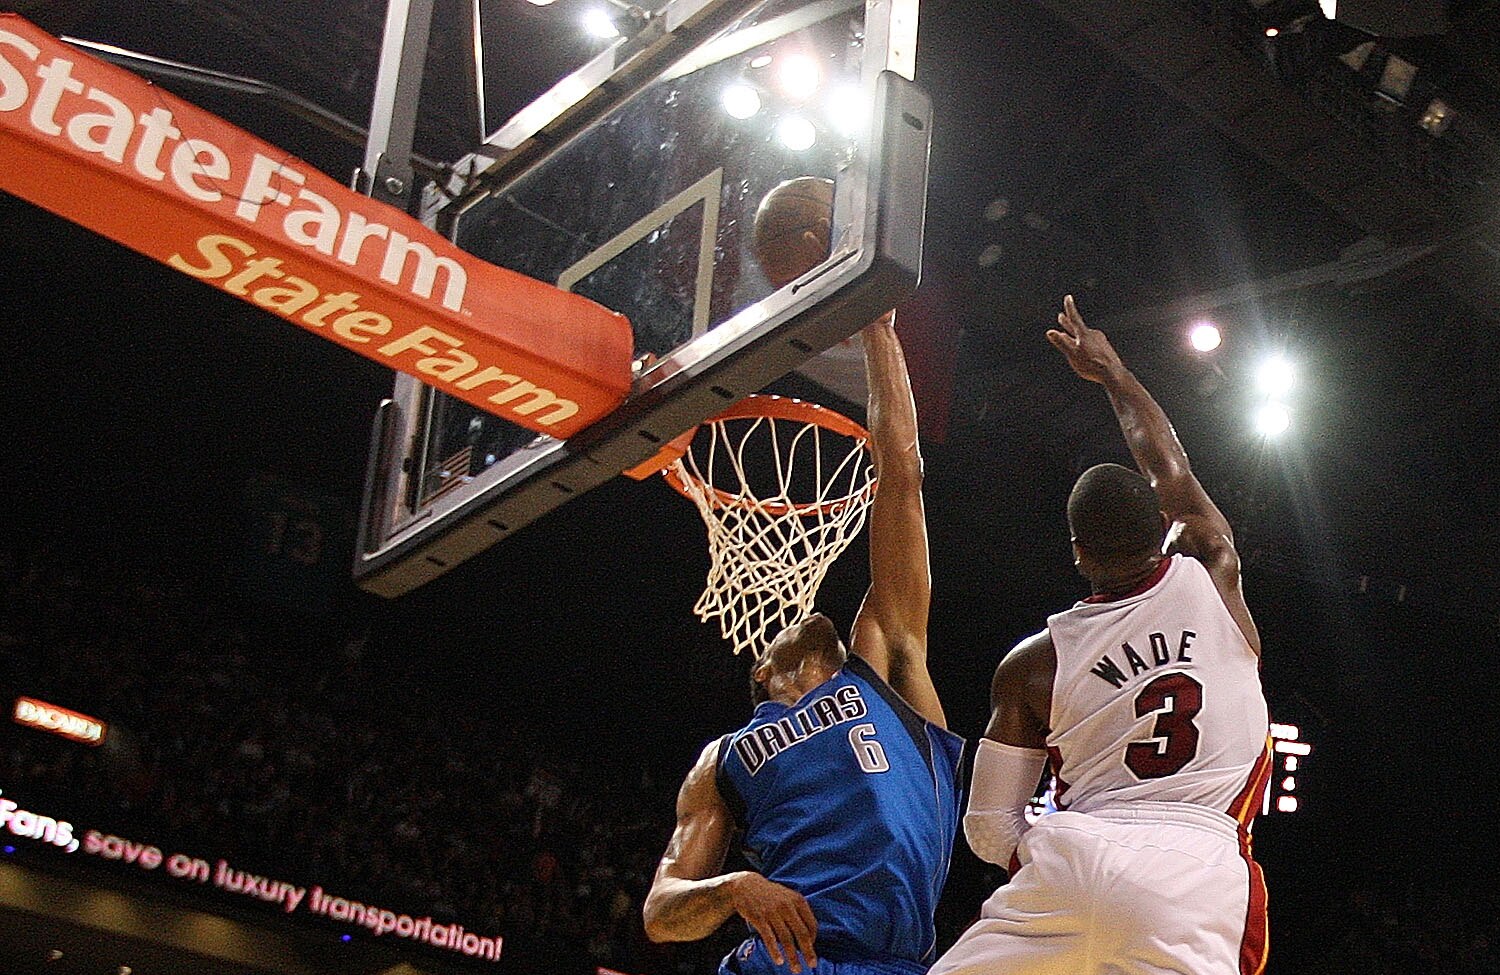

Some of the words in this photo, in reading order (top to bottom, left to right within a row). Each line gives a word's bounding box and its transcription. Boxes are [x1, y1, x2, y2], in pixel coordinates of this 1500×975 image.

[0, 27, 232, 203] State
[235, 152, 468, 313] Farm
[167, 233, 393, 344] State
[377, 326, 580, 426] Farm
[1090, 631, 1196, 689] WADE
[735, 685, 868, 777] DALLAS
[848, 723, 891, 774] 6
[1123, 670, 1205, 782] 3
[83, 829, 164, 871] save
[166, 853, 210, 884] on
[213, 858, 306, 914] luxury
